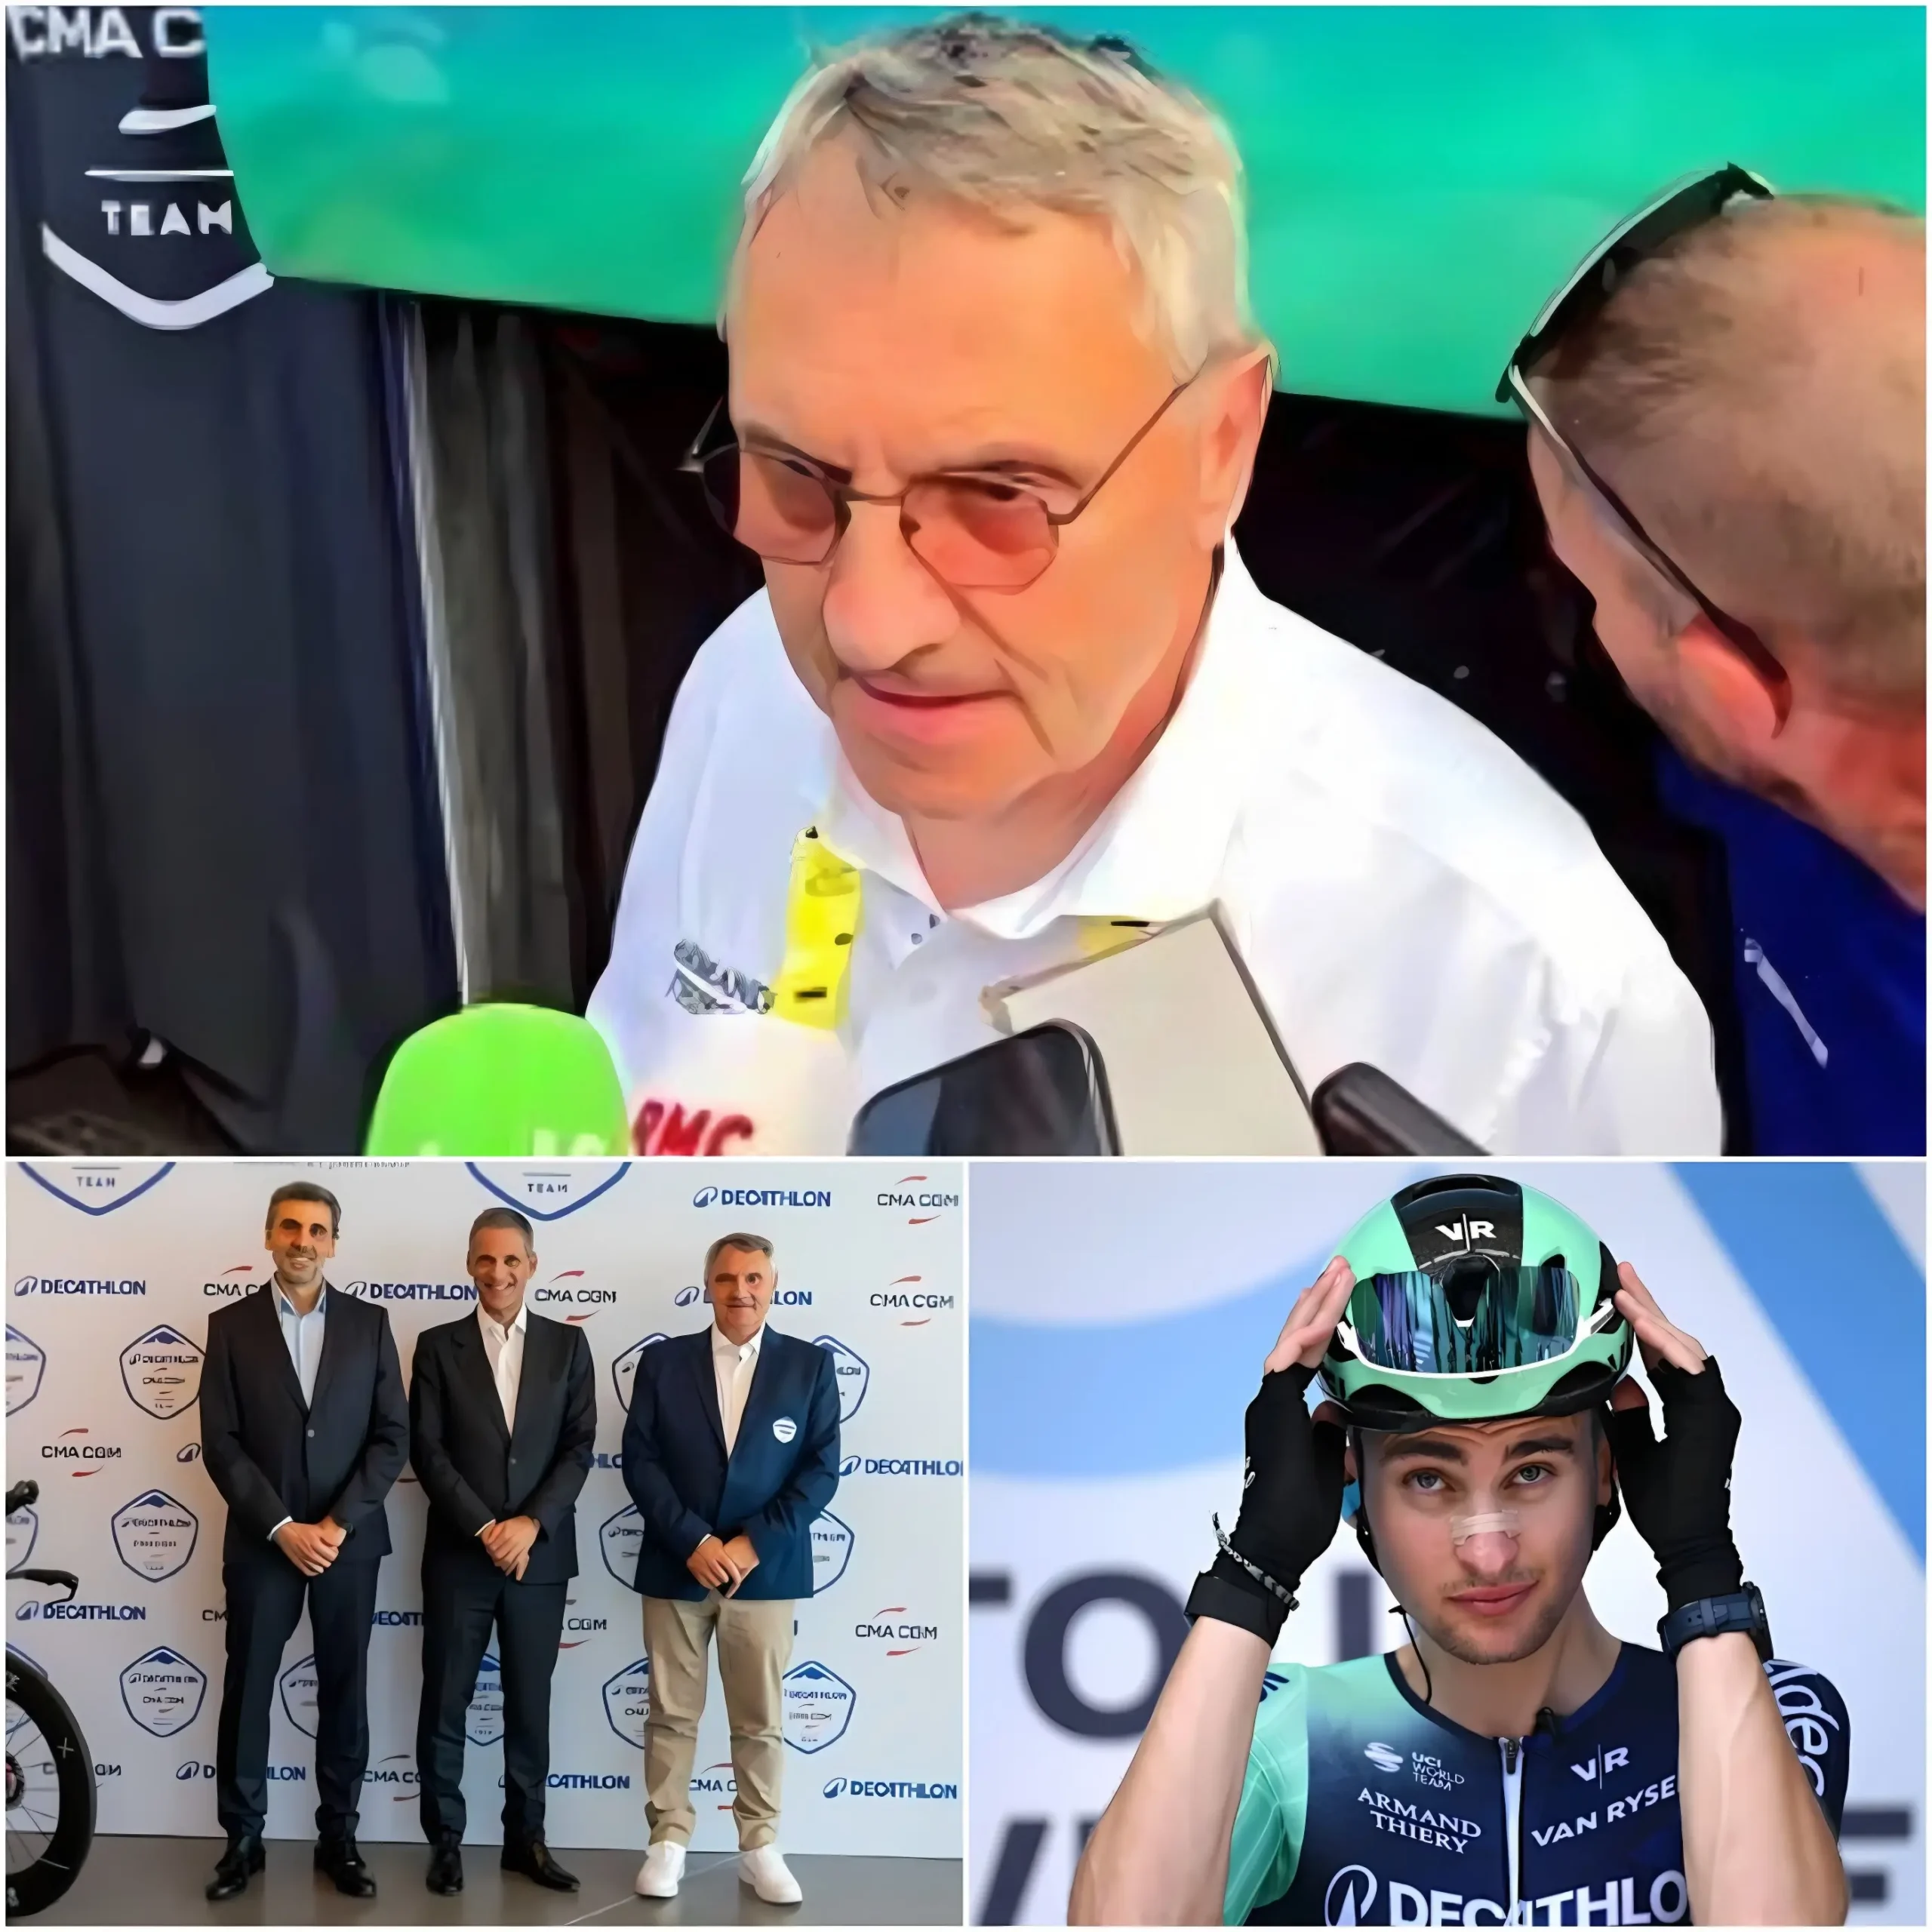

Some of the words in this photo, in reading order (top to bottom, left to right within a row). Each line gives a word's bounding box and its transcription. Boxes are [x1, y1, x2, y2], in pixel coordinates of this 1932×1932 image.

[101, 200, 232, 235] TEAM
[721, 1189, 831, 1207] DECATHLON
[41, 1279, 146, 1296] DECATHLON
[371, 1283, 478, 1300] DECATHLON
[42, 1445, 79, 1458] CMA
[43, 1604, 146, 1620] DECATHLON
[855, 1624, 894, 1639] CMA
[1412, 1752, 1441, 1767] UCI
[546, 1774, 630, 1789] CATHLON
[1413, 1761, 1464, 1784] WORLD
[851, 1780, 958, 1799] DECATHLON
[1357, 1787, 1481, 1838] ARMAND
[1531, 1811, 1598, 1847] VAN
[1607, 1774, 1675, 1816] RYSE
[1370, 1810, 1469, 1854] THIERY
[1389, 1869, 1688, 1926] DECATHLO
